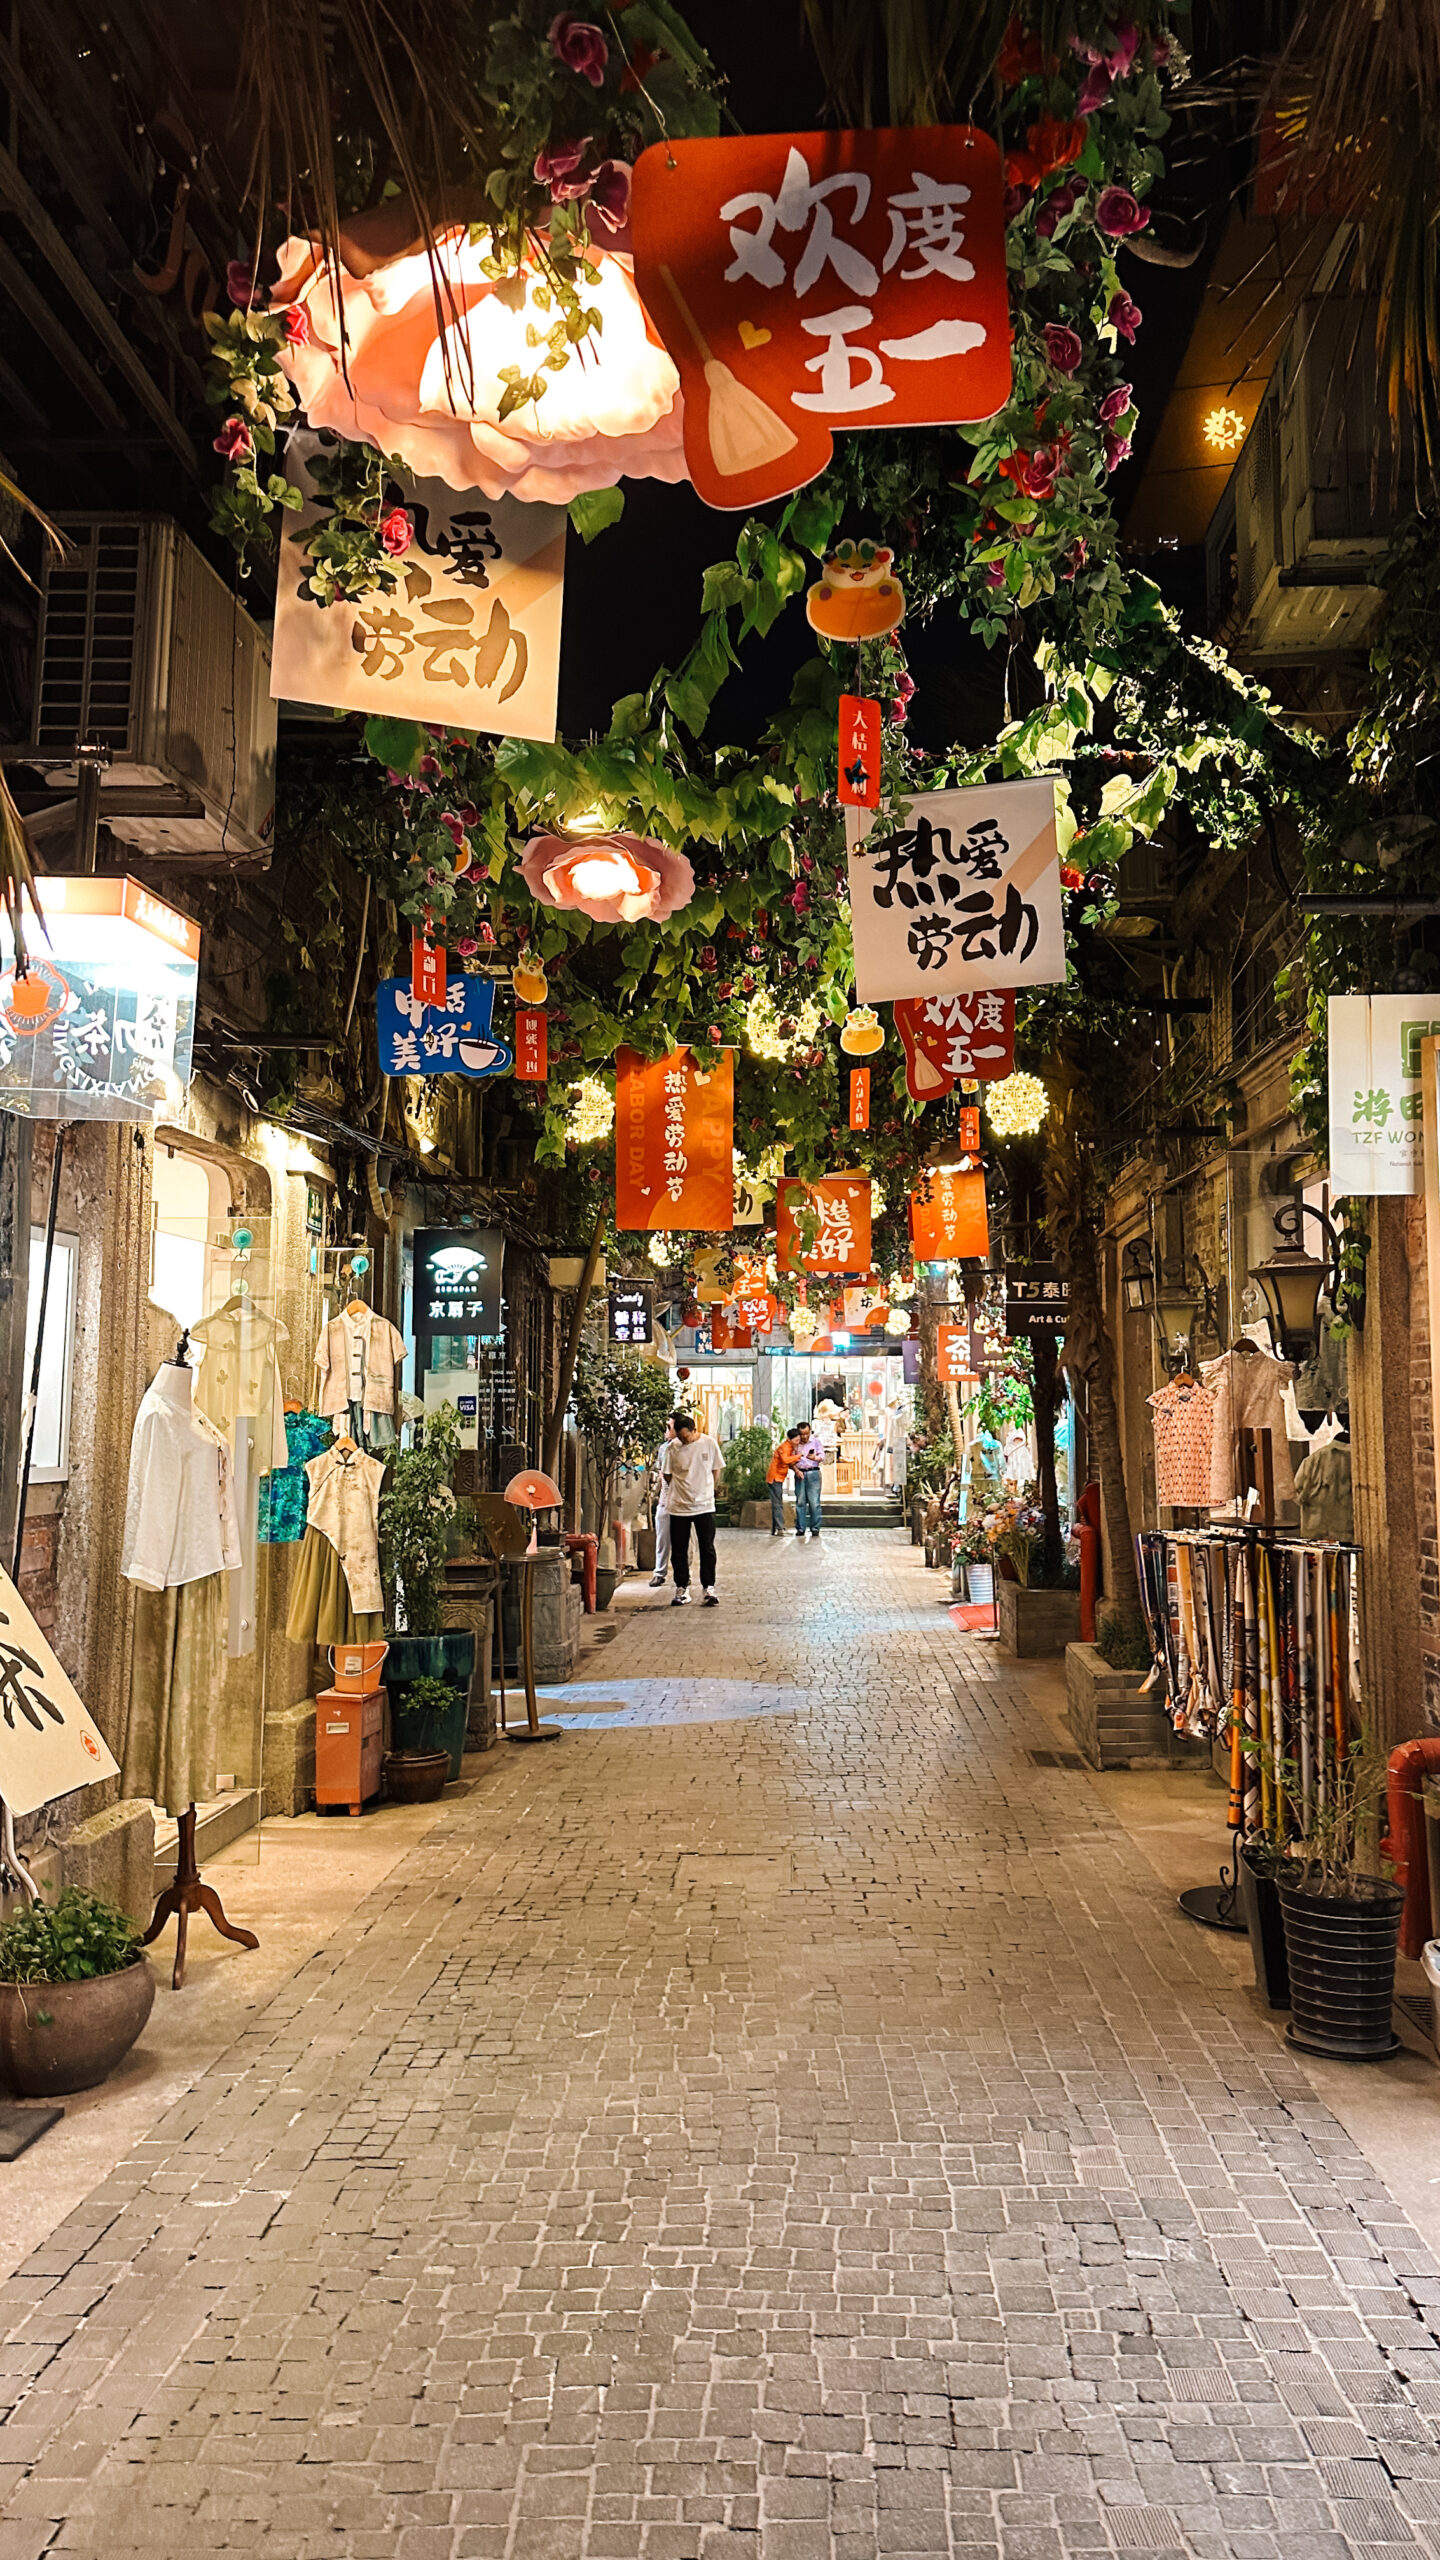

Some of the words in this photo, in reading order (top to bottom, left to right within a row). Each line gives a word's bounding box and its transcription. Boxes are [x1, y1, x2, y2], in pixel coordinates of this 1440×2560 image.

[719, 146, 976, 299] 欢度
[790, 305, 988, 413] 五一
[352, 598, 528, 704] 劳动
[868, 817, 1009, 909] 热爱
[908, 882, 1039, 971] 劳动
[923, 992, 1006, 1034] 欢度
[390, 1022, 459, 1071] 美好
[941, 1035, 1007, 1074] 五一
[663, 1069, 688, 1203] 热爱劳动节
[1352, 1131, 1383, 1144] TZF
[629, 1146, 645, 1188] DAY
[737, 1279, 764, 1295] 五一
[742, 1299, 768, 1313] 欢度
[428, 1300, 483, 1318] 京扇子
[746, 1313, 767, 1326] 五一
[1028, 1314, 1044, 1324] Art
[1045, 1315, 1054, 1324] &
